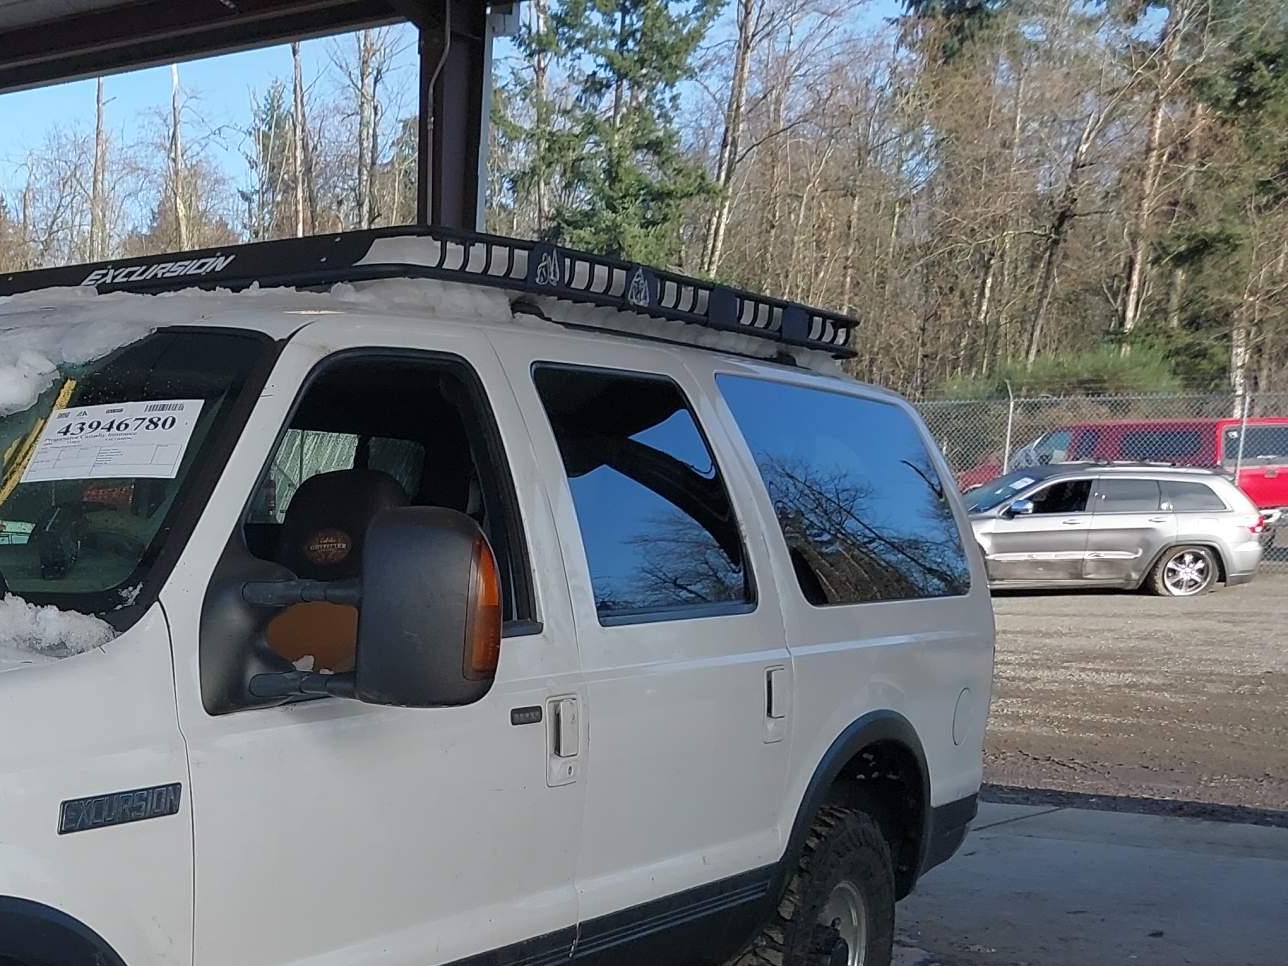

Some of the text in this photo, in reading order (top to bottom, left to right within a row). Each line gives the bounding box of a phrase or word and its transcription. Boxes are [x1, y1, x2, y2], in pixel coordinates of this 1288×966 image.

[81, 253, 236, 286] EXCURSION
[56, 415, 177, 437] 43946780
[64, 786, 181, 829] EXCURSION
